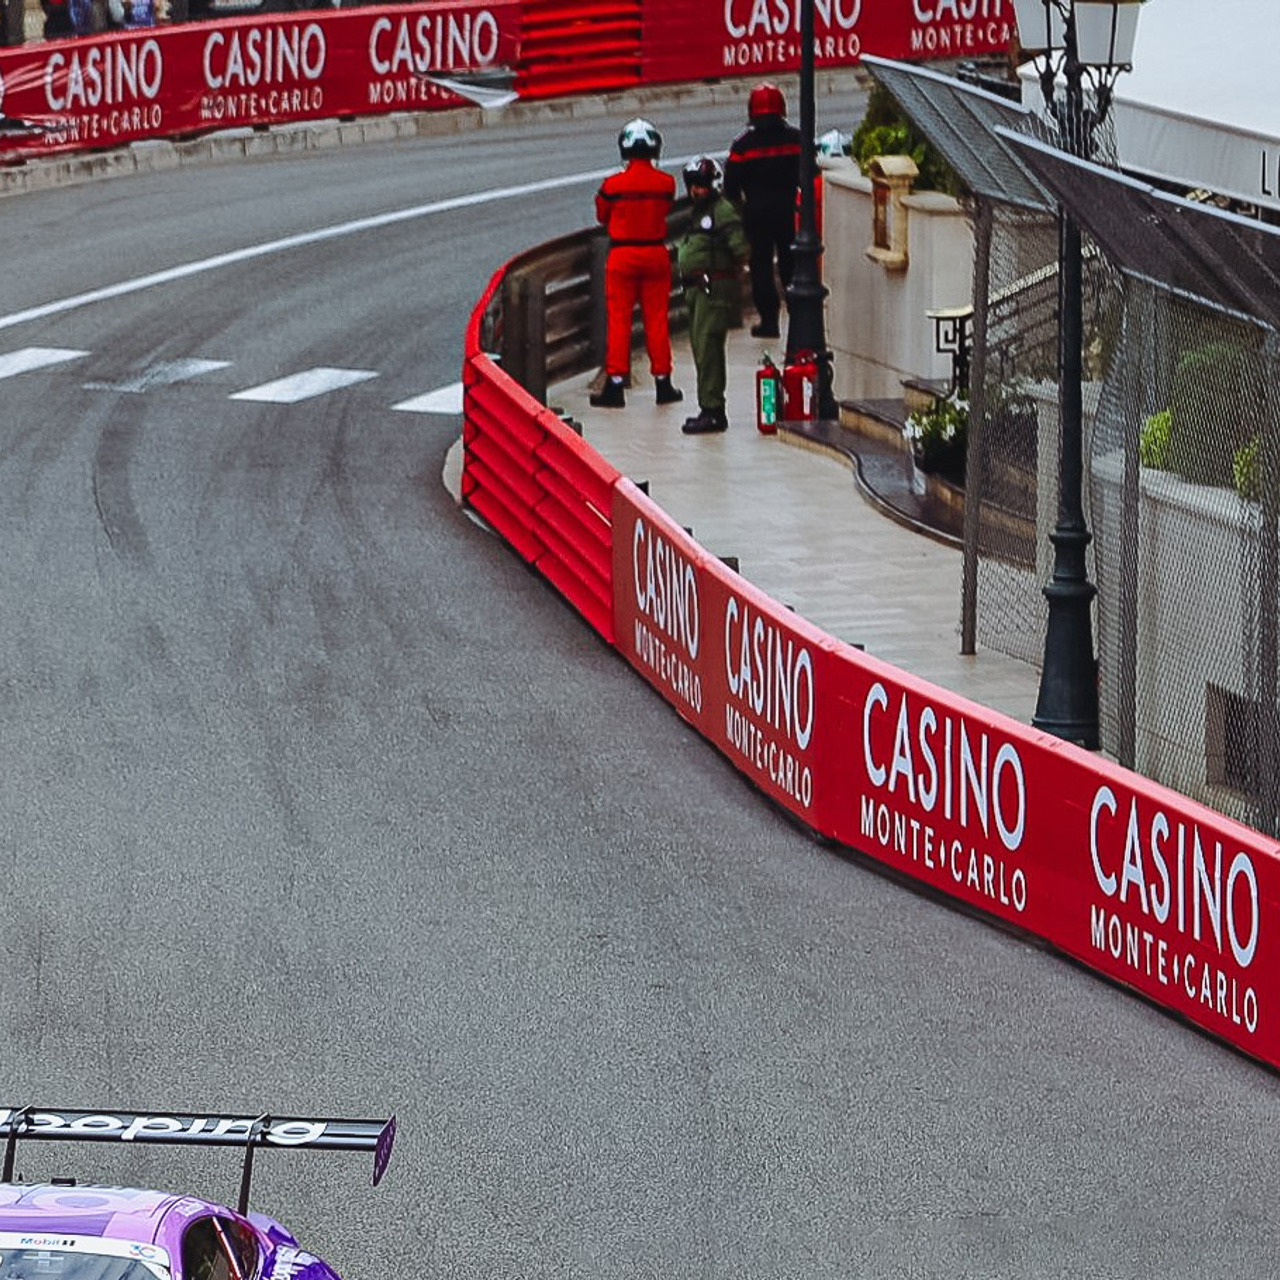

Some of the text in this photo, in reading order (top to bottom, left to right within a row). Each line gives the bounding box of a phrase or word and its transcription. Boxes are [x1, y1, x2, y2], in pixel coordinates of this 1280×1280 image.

[45, 39, 163, 110] CASINO
[203, 22, 326, 89] CASINO
[369, 10, 498, 74] CASINO
[633, 518, 699, 660] CASINO
[725, 597, 814, 750] CASINO
[863, 682, 1026, 851] CASINO
[1090, 786, 1260, 968] CASINO
